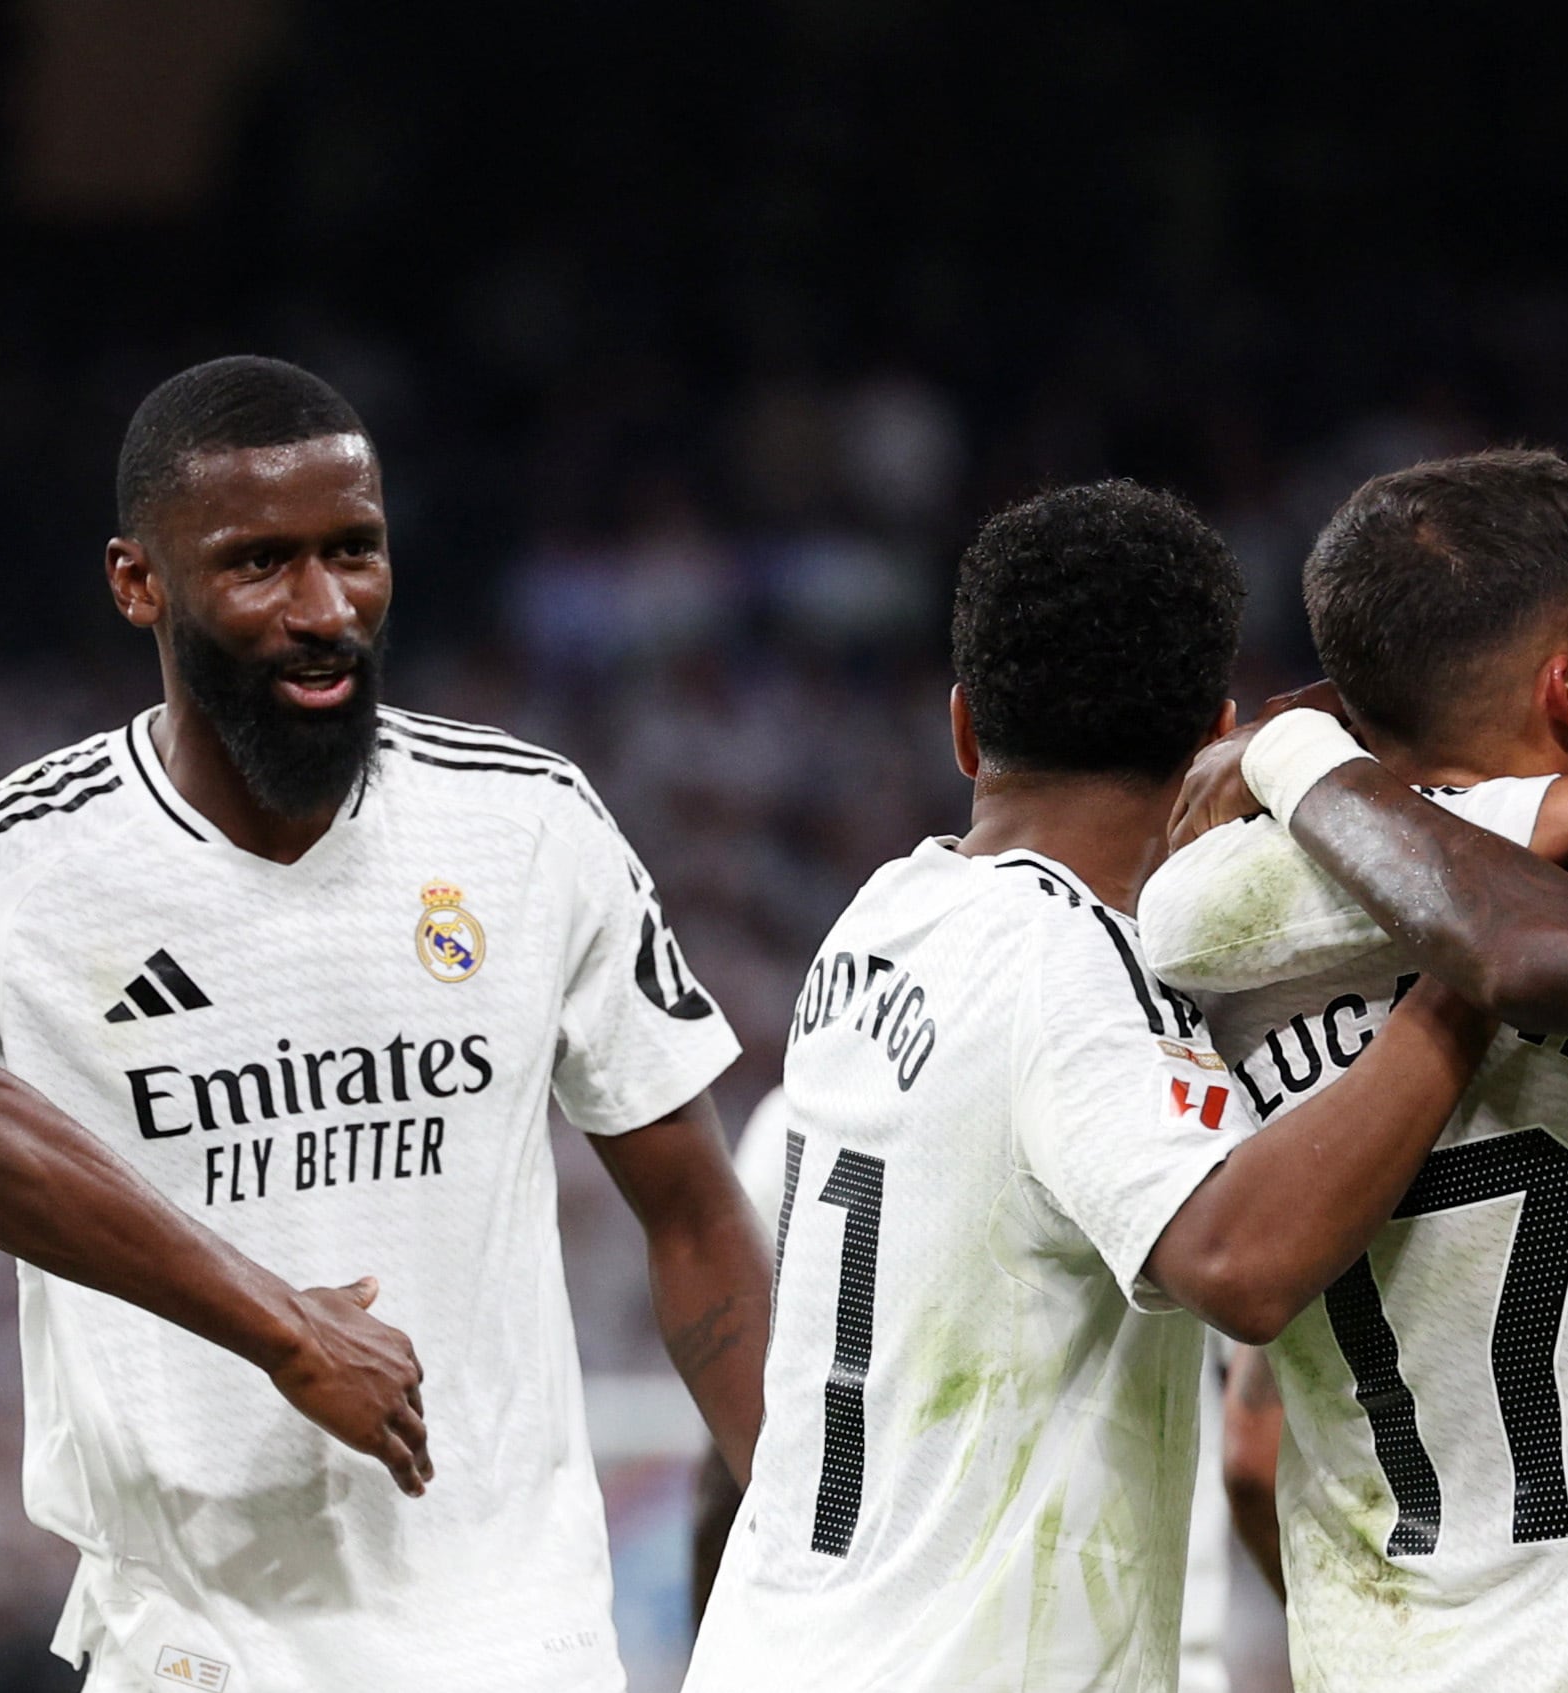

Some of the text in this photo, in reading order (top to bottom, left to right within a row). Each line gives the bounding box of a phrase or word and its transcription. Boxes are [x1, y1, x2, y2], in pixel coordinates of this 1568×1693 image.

[124, 1033, 494, 1140] Emirates
[205, 1116, 445, 1205] FLY BETTER
